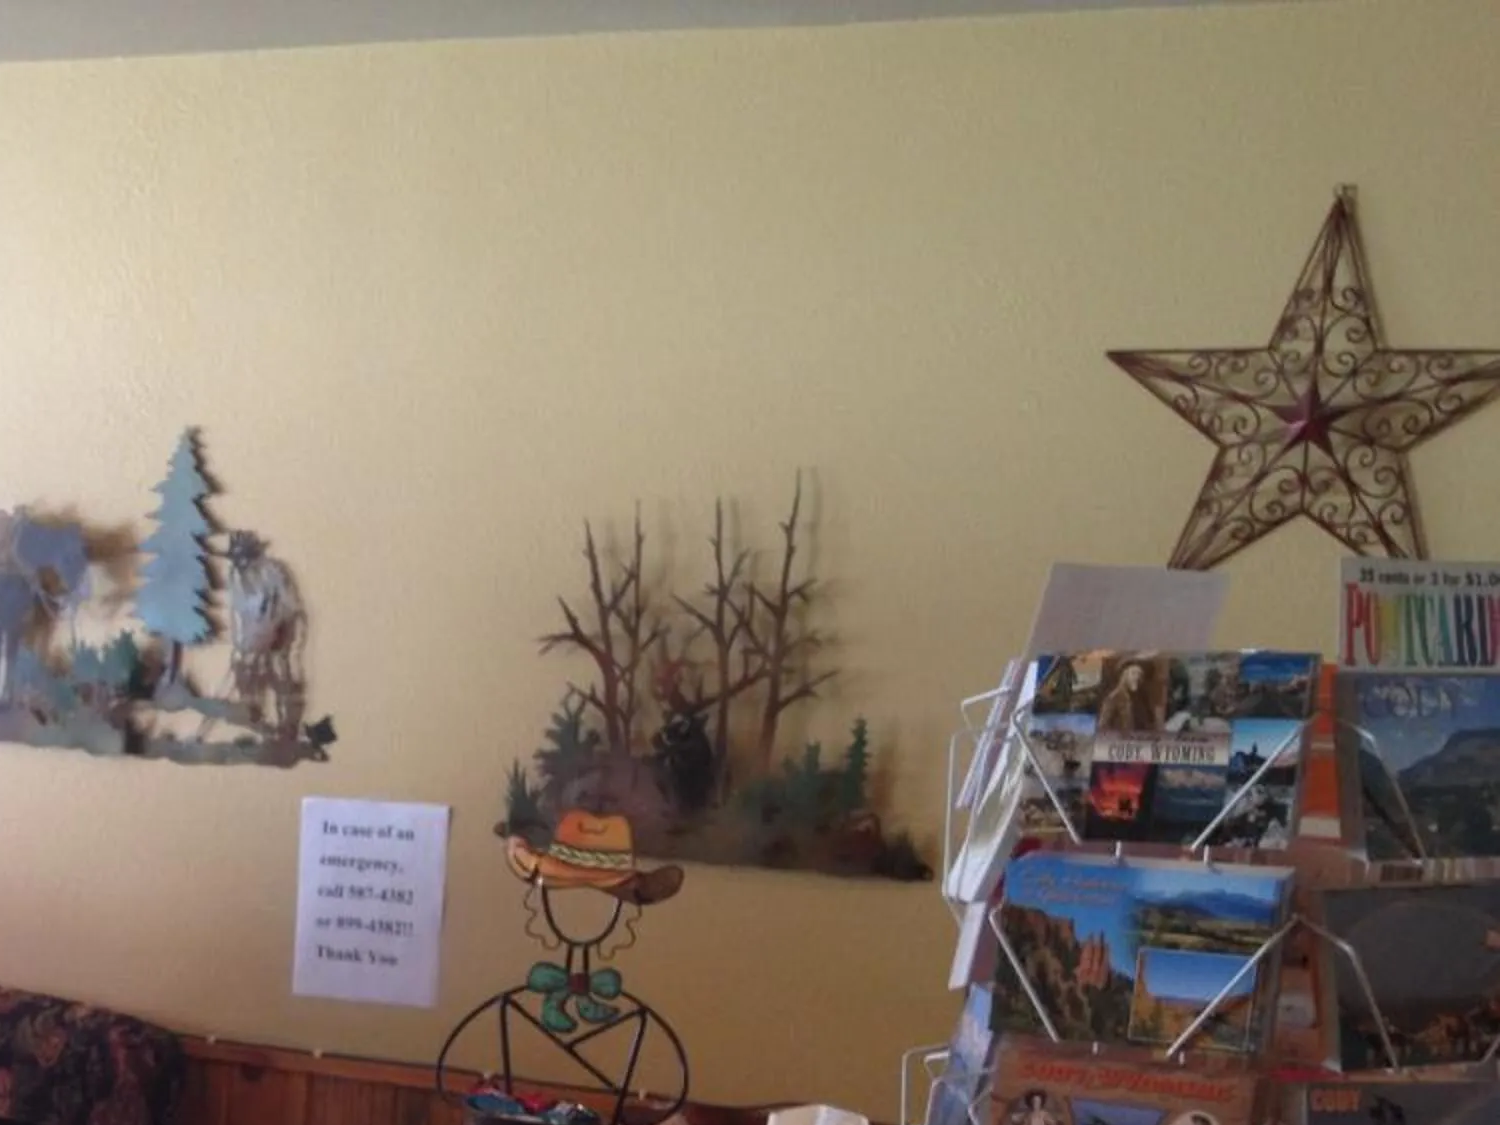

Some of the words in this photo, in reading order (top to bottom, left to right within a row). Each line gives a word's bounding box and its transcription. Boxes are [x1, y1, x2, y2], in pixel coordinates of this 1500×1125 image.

[1464, 570, 1500, 587] $1.0
[1345, 581, 1500, 667] POSTCARD
[1150, 740, 1216, 765] WYOMING
[322, 820, 339, 834] In
[342, 824, 373, 839] case
[376, 825, 394, 839] of
[396, 829, 415, 842] an
[316, 884, 344, 899] call
[315, 916, 332, 929] or
[316, 944, 363, 962] Thank
[367, 948, 399, 966] You
